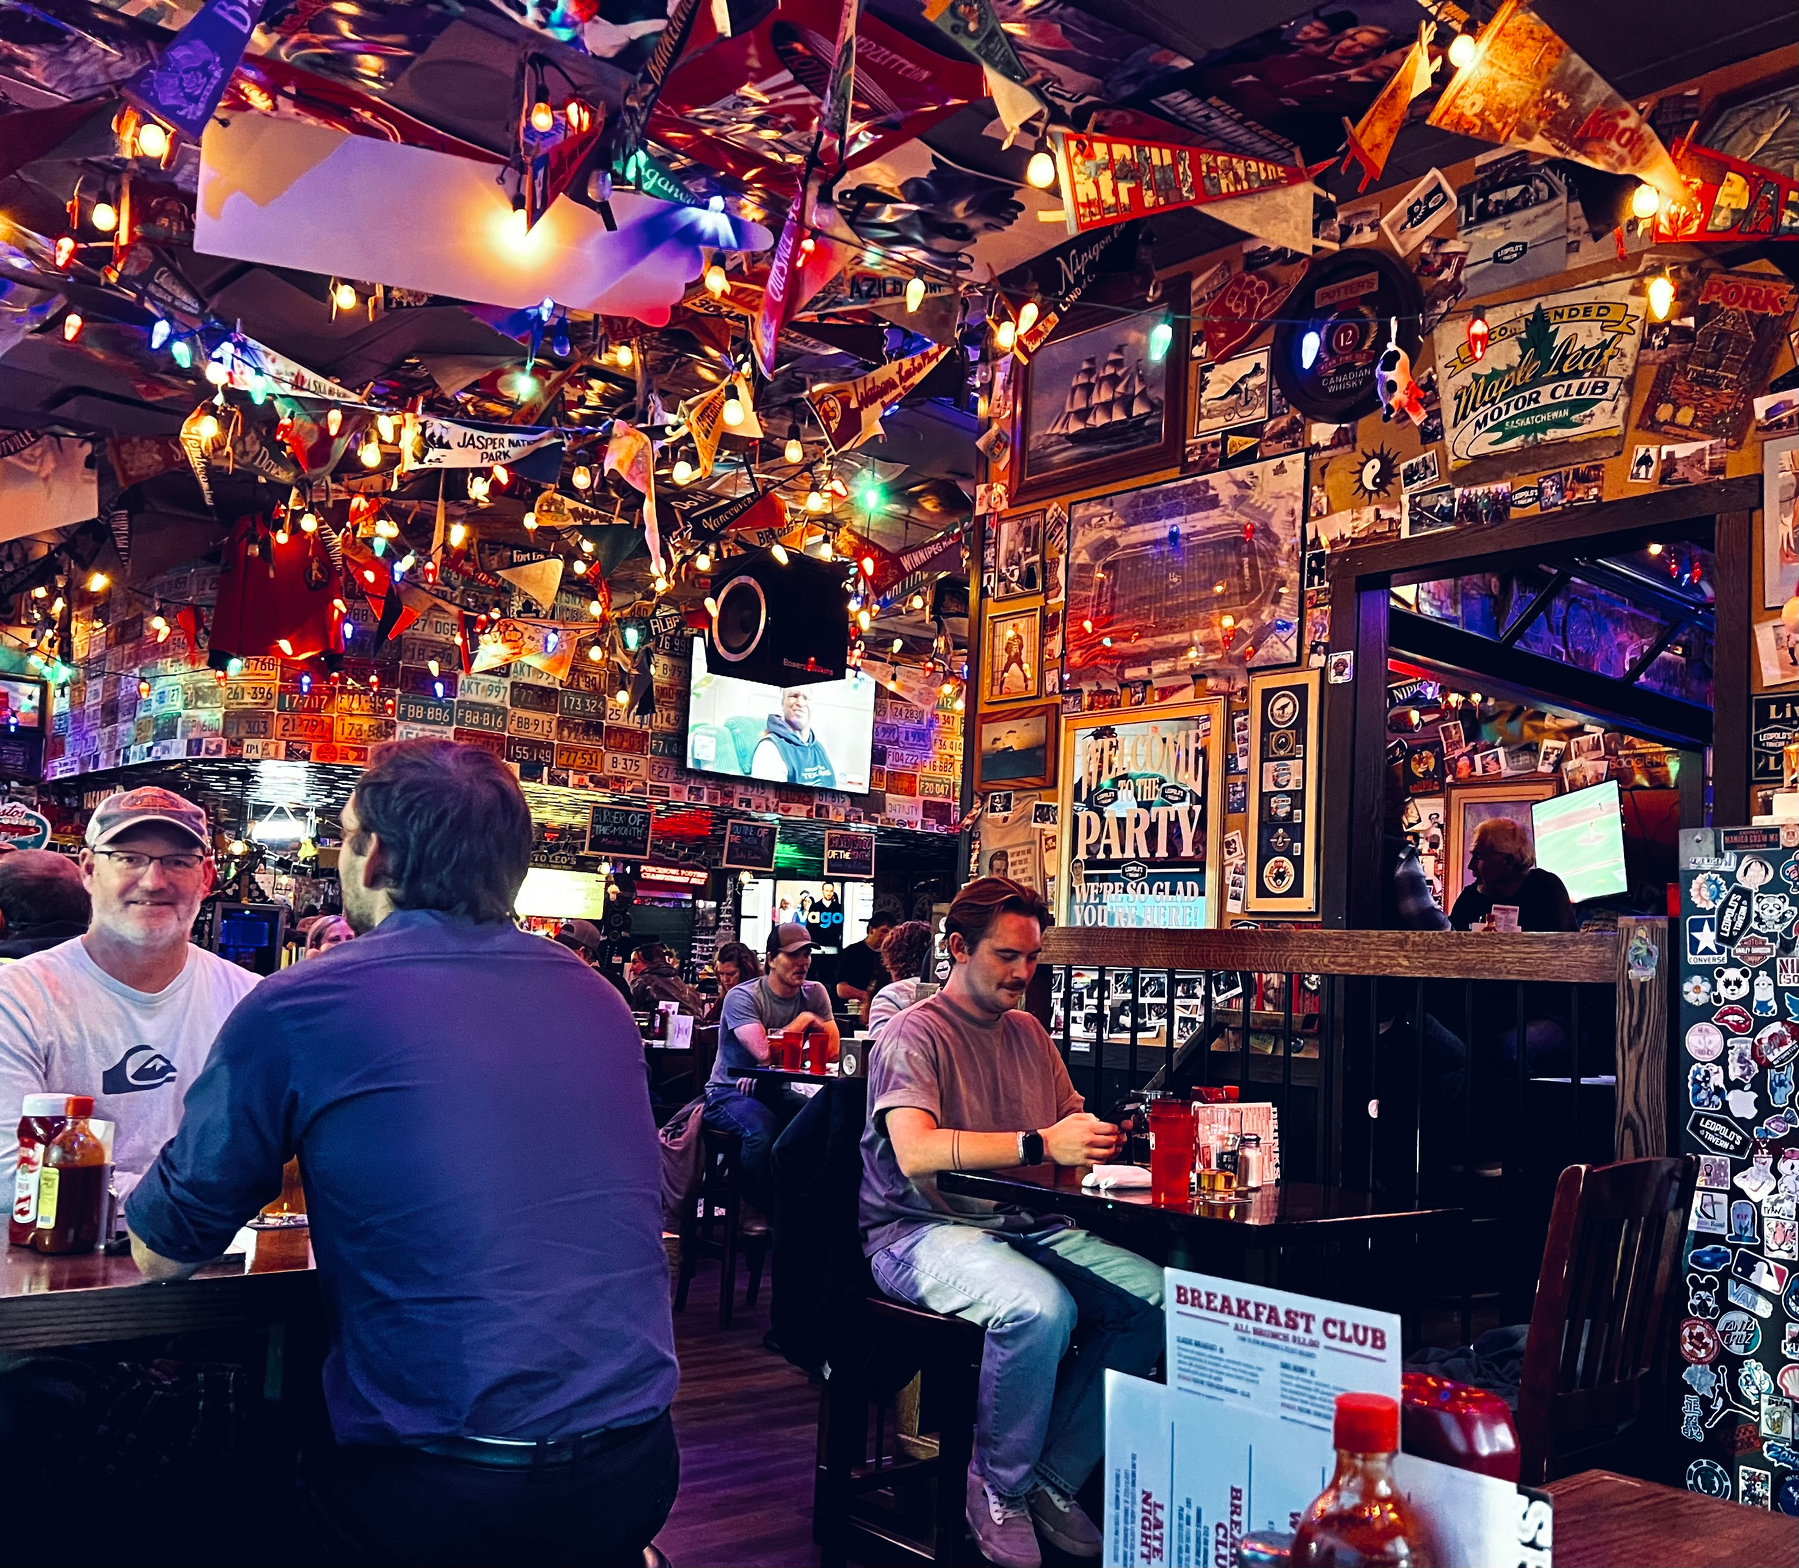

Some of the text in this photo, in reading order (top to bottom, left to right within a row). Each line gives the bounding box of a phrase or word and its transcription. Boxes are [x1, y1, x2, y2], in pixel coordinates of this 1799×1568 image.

[1056, 233, 1112, 296] Nipigon
[1321, 278, 1375, 301] POTTER'S
[1702, 277, 1787, 315] PORK
[1340, 330, 1353, 347] 12
[1321, 368, 1371, 387] CANADIAN
[1327, 379, 1364, 393] WHISKY
[1453, 333, 1624, 428] Maple Leaf
[1474, 381, 1609, 436] MOTOR CLUB
[1505, 408, 1570, 430] SASKATCHEWAN
[457, 432, 505, 451] JASPER
[480, 450, 511, 463] PARK
[702, 496, 753, 531] Vancouver
[513, 550, 531, 563] Fort
[900, 543, 942, 573] WINNIPEG
[226, 686, 273, 701] 261-396
[460, 680, 480, 694] AKT
[488, 683, 508, 697] 997
[559, 750, 599, 767] F77-531
[1081, 729, 1202, 802] WELCOME
[1118, 778, 1160, 801] TO THE
[628, 813, 645, 826] OF
[1076, 805, 1202, 860] PARTY
[550, 853, 577, 865] LEO'S
[1075, 881, 1199, 904] WE'RE SO GLAD
[1074, 905, 1199, 927] YOU'RE HERE!
[1720, 893, 1742, 938] LEOPOLD'S
[1688, 956, 1726, 964] CONVERSE
[1699, 1117, 1742, 1146] LEOPOLD'S
[1703, 1130, 1730, 1151] TAVERN
[1176, 1284, 1317, 1334] BREAKFAST
[1322, 1317, 1387, 1351] CLUB
[1718, 1319, 1756, 1332] SANTA
[1233, 1323, 1250, 1335] ALL
[1723, 1333, 1754, 1345] CRUZ
[1140, 1489, 1152, 1565] NIGHT
[1152, 1500, 1165, 1562] LATE
